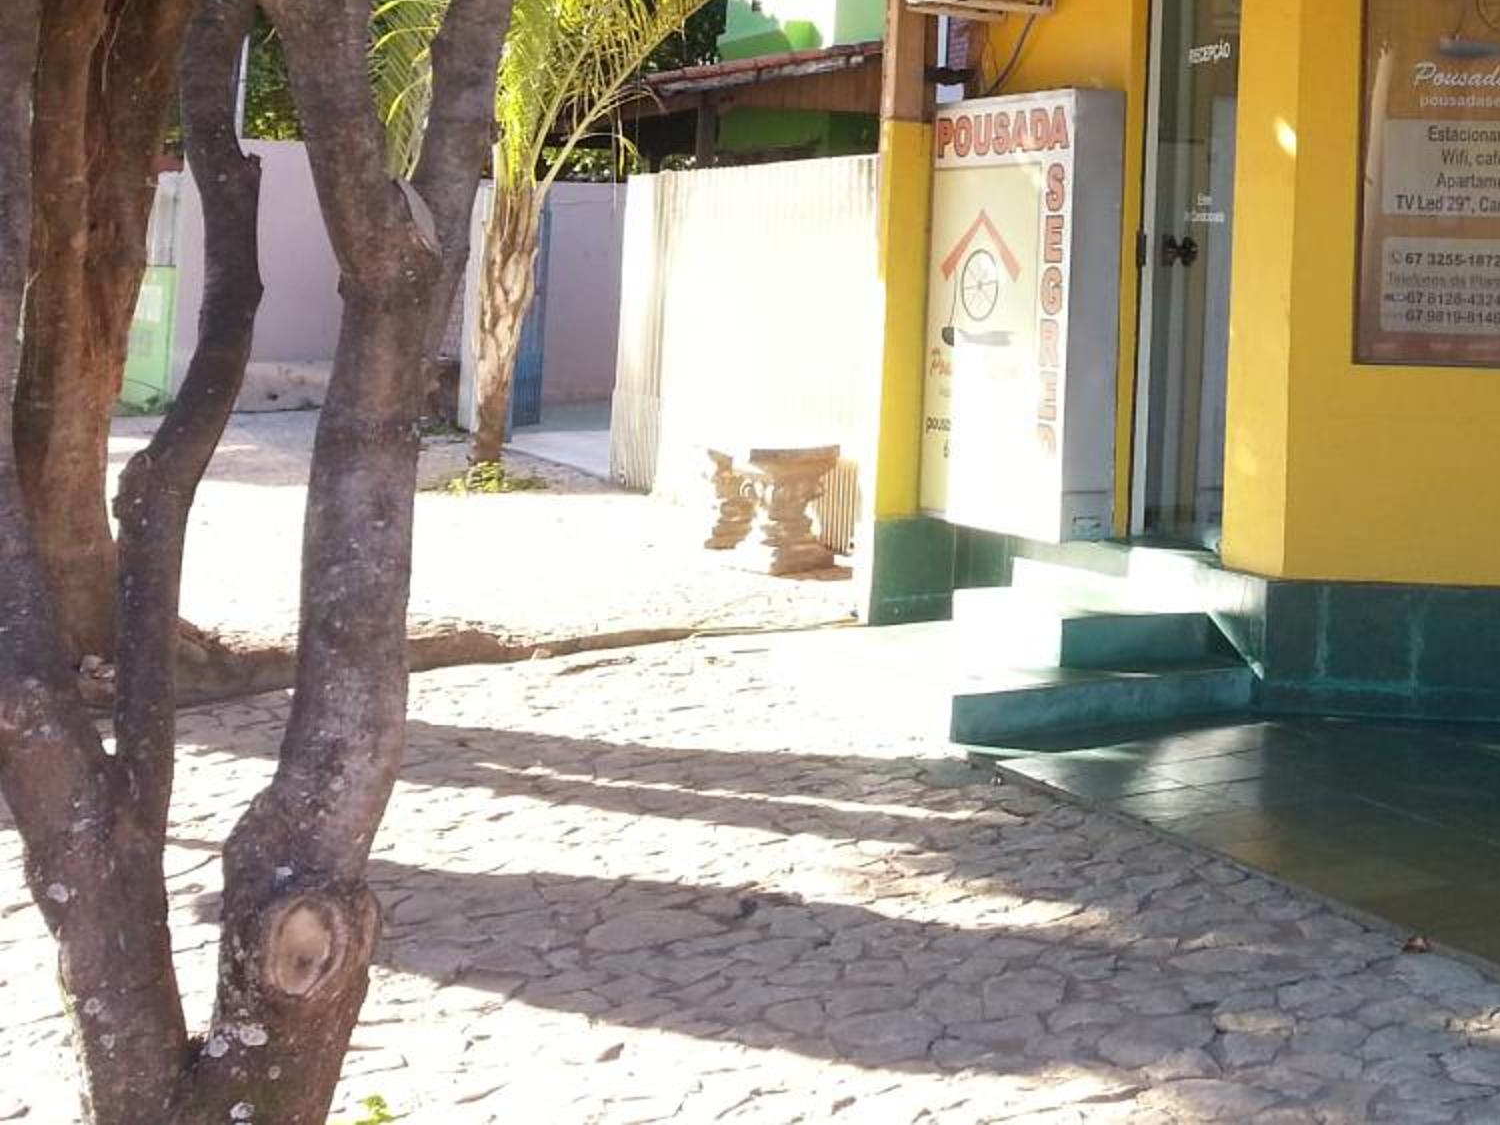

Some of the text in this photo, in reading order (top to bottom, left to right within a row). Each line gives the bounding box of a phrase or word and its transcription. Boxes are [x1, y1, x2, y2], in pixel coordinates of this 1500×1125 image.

[937, 105, 1071, 159] POUSADA
[1396, 194, 1415, 210] TV
[1418, 194, 1443, 211] Led
[1405, 252, 1422, 264] 67
